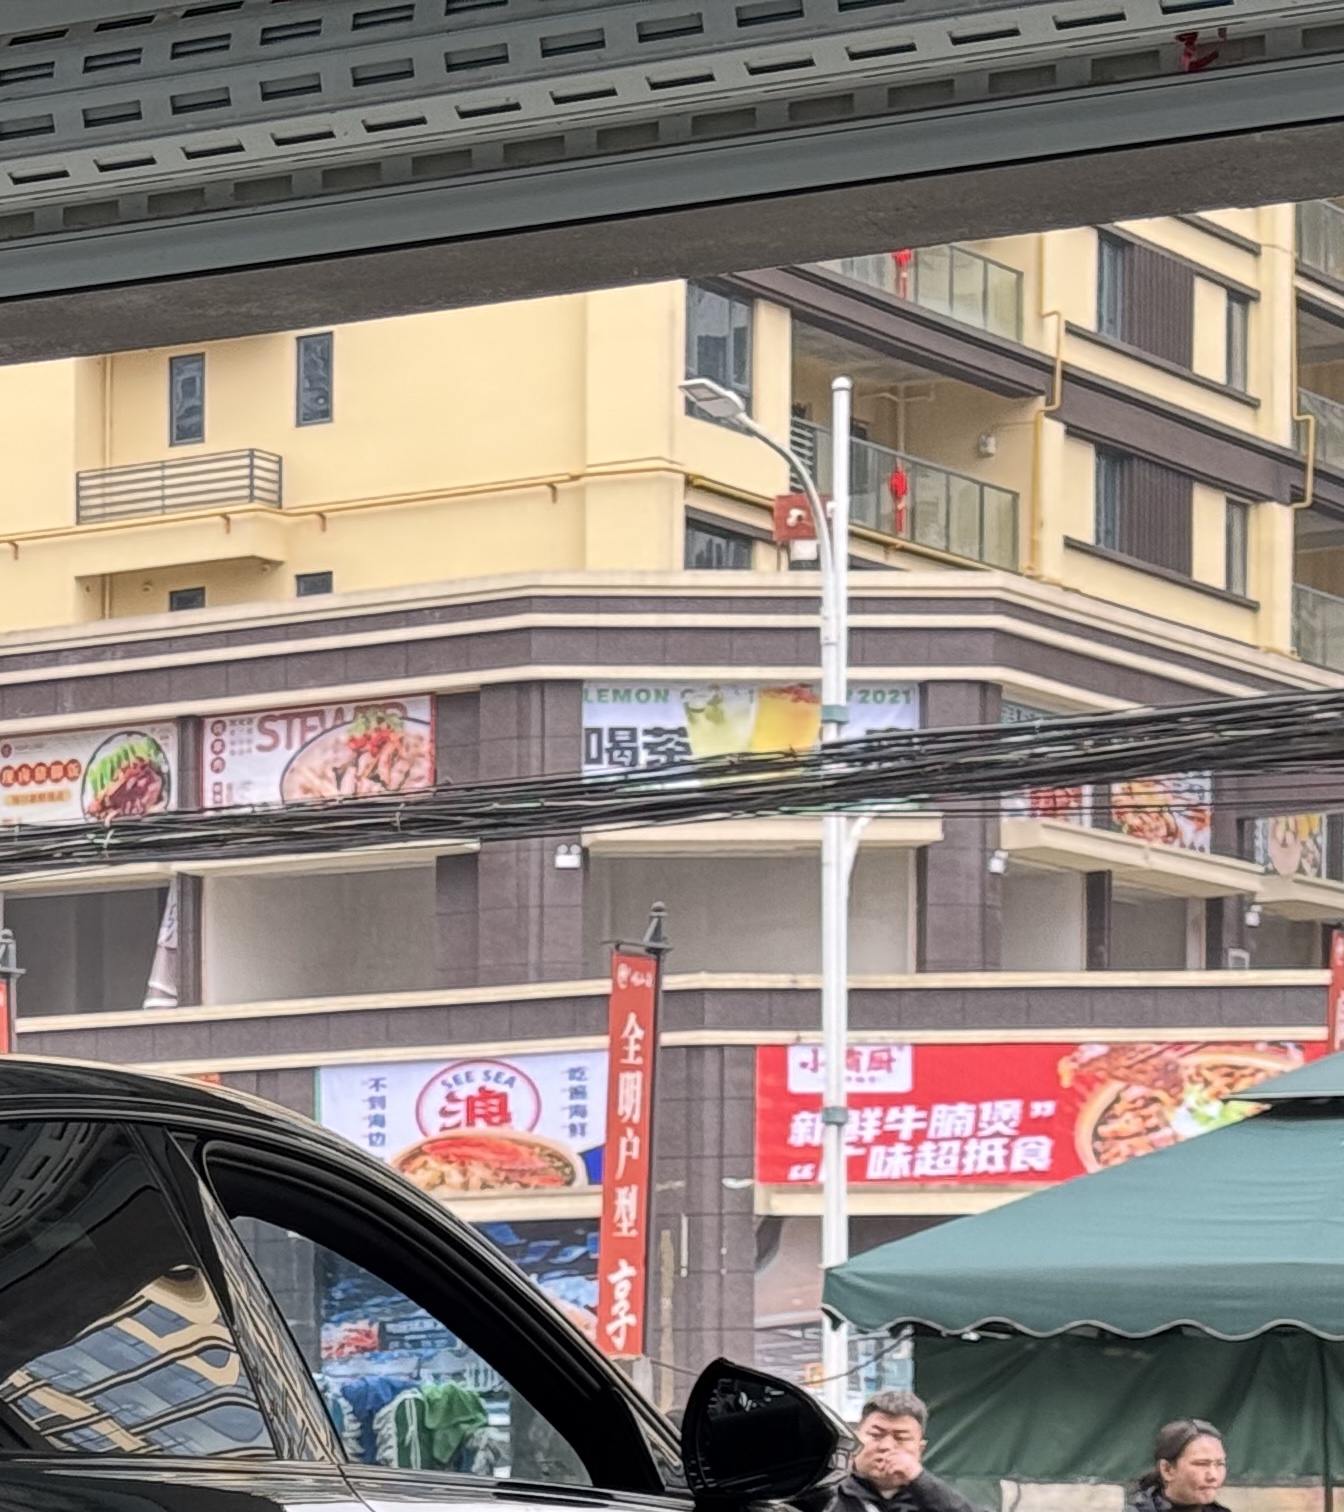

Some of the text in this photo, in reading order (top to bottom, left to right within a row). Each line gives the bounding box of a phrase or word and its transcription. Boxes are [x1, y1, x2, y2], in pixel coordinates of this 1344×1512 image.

[583, 688, 670, 704] LEMON
[857, 689, 912, 704] 2021
[441, 1069, 517, 1090] SEE SEA
